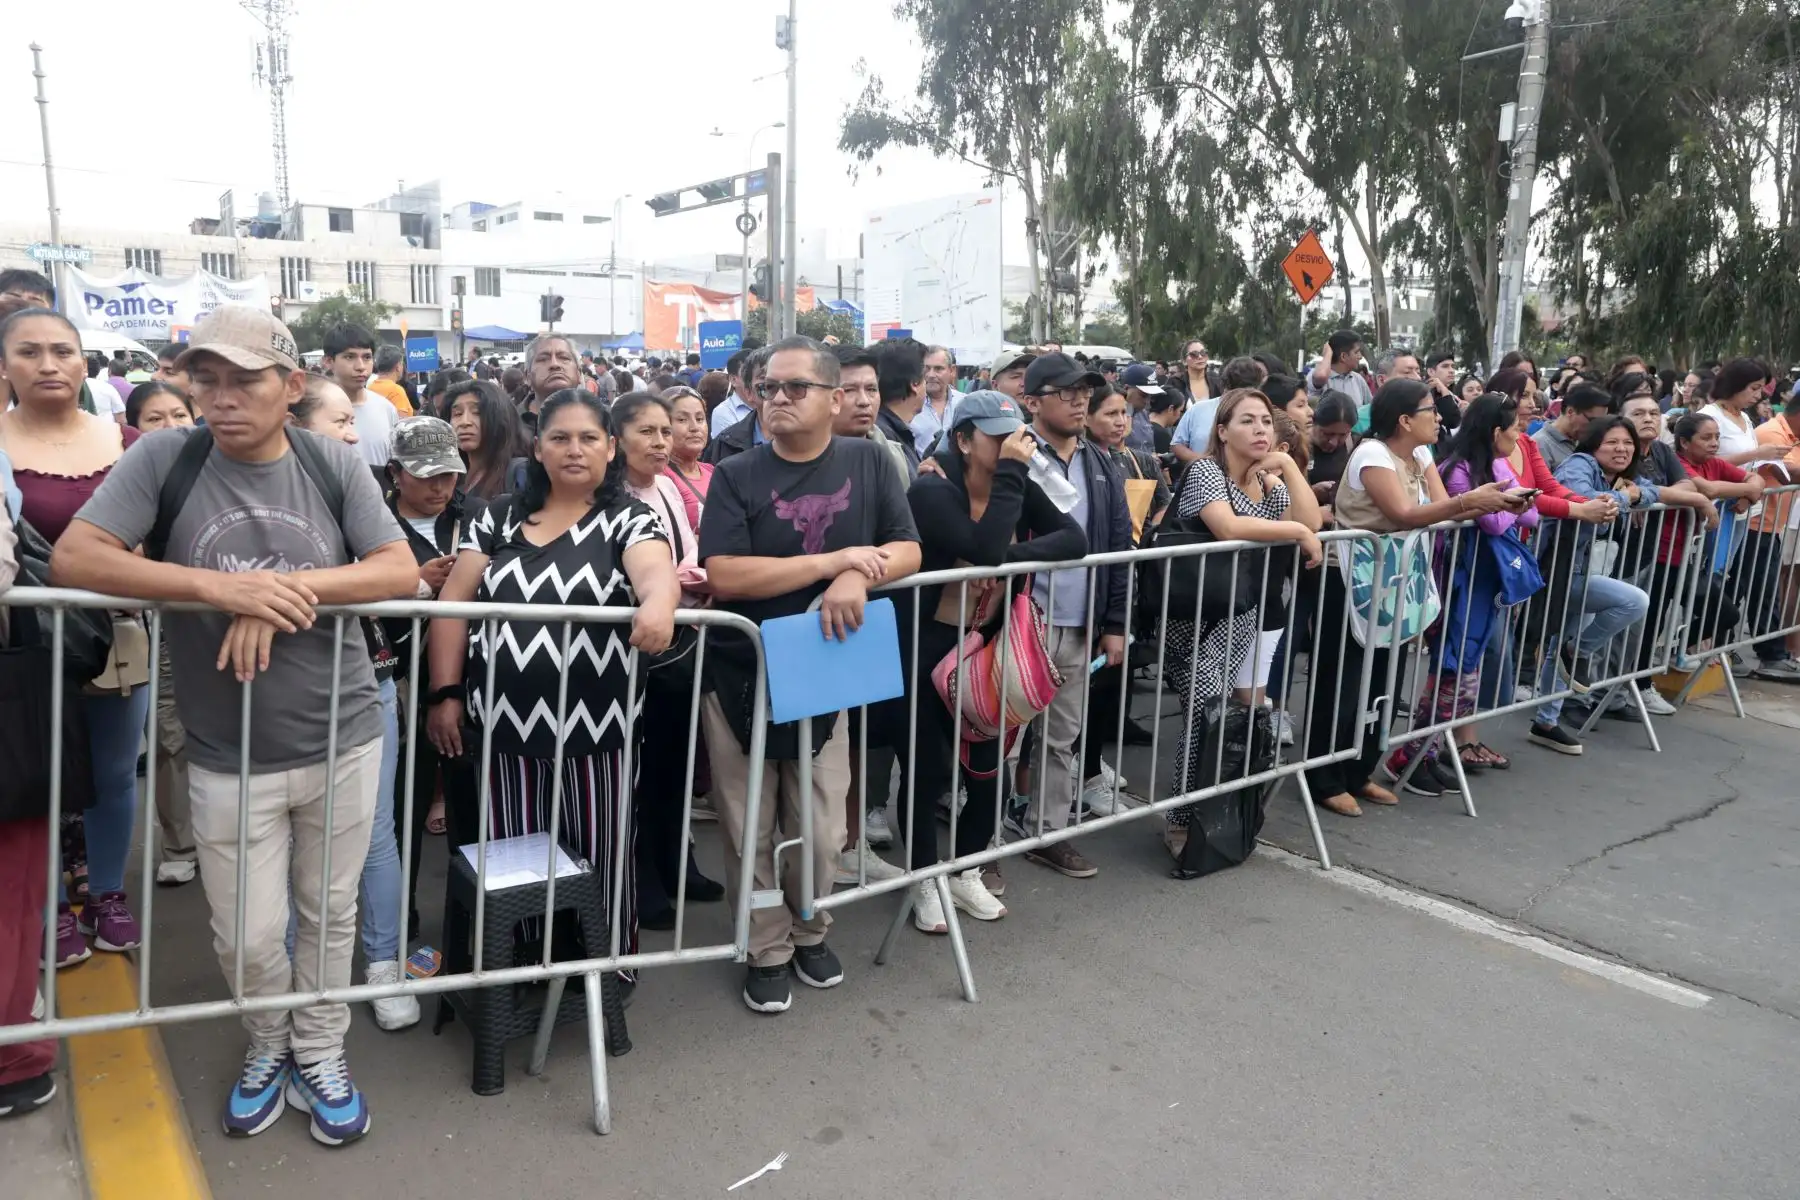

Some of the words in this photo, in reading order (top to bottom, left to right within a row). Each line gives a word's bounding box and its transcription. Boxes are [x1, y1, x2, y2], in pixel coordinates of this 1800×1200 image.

[1295, 254, 1324, 264] DESVIO
[84, 291, 178, 317] Pamer
[103, 319, 168, 329] ACADEMIAS
[703, 338, 725, 348] Aula
